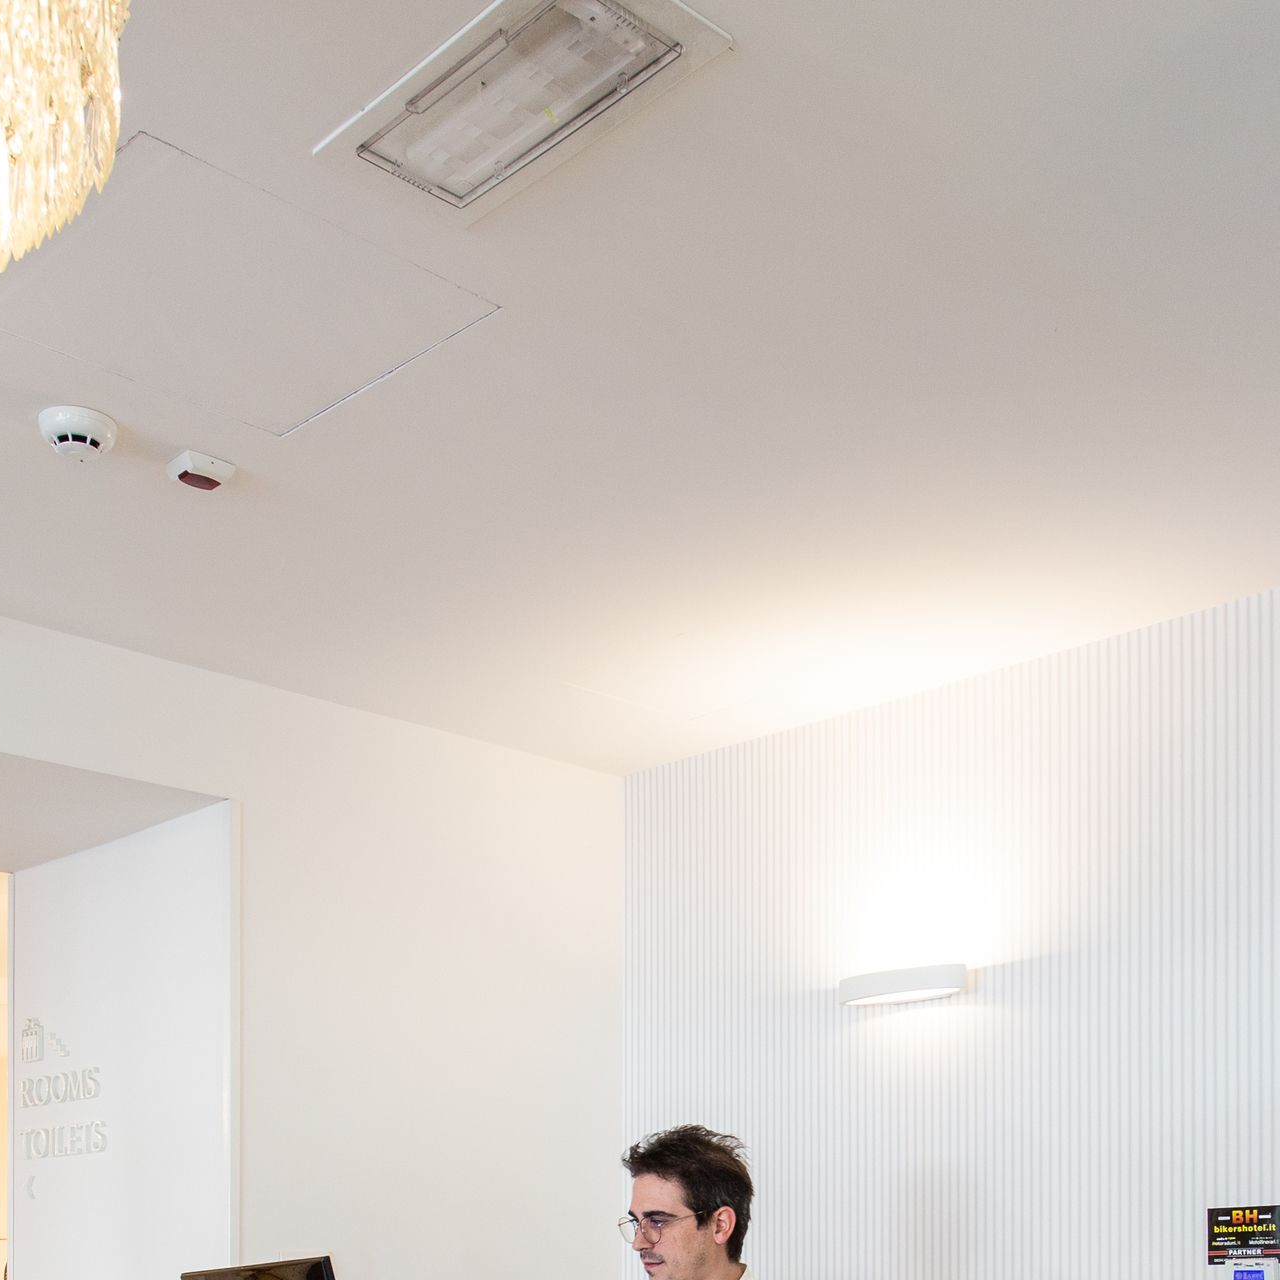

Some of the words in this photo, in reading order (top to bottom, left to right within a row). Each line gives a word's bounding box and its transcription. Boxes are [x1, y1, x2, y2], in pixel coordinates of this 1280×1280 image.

[19, 1066, 101, 1108] ROOMS
[19, 1120, 108, 1160] TOILETS
[1232, 1209, 1259, 1224] BH
[1213, 1223, 1277, 1234] bikershotel.it
[1228, 1248, 1263, 1256] PARTNER
